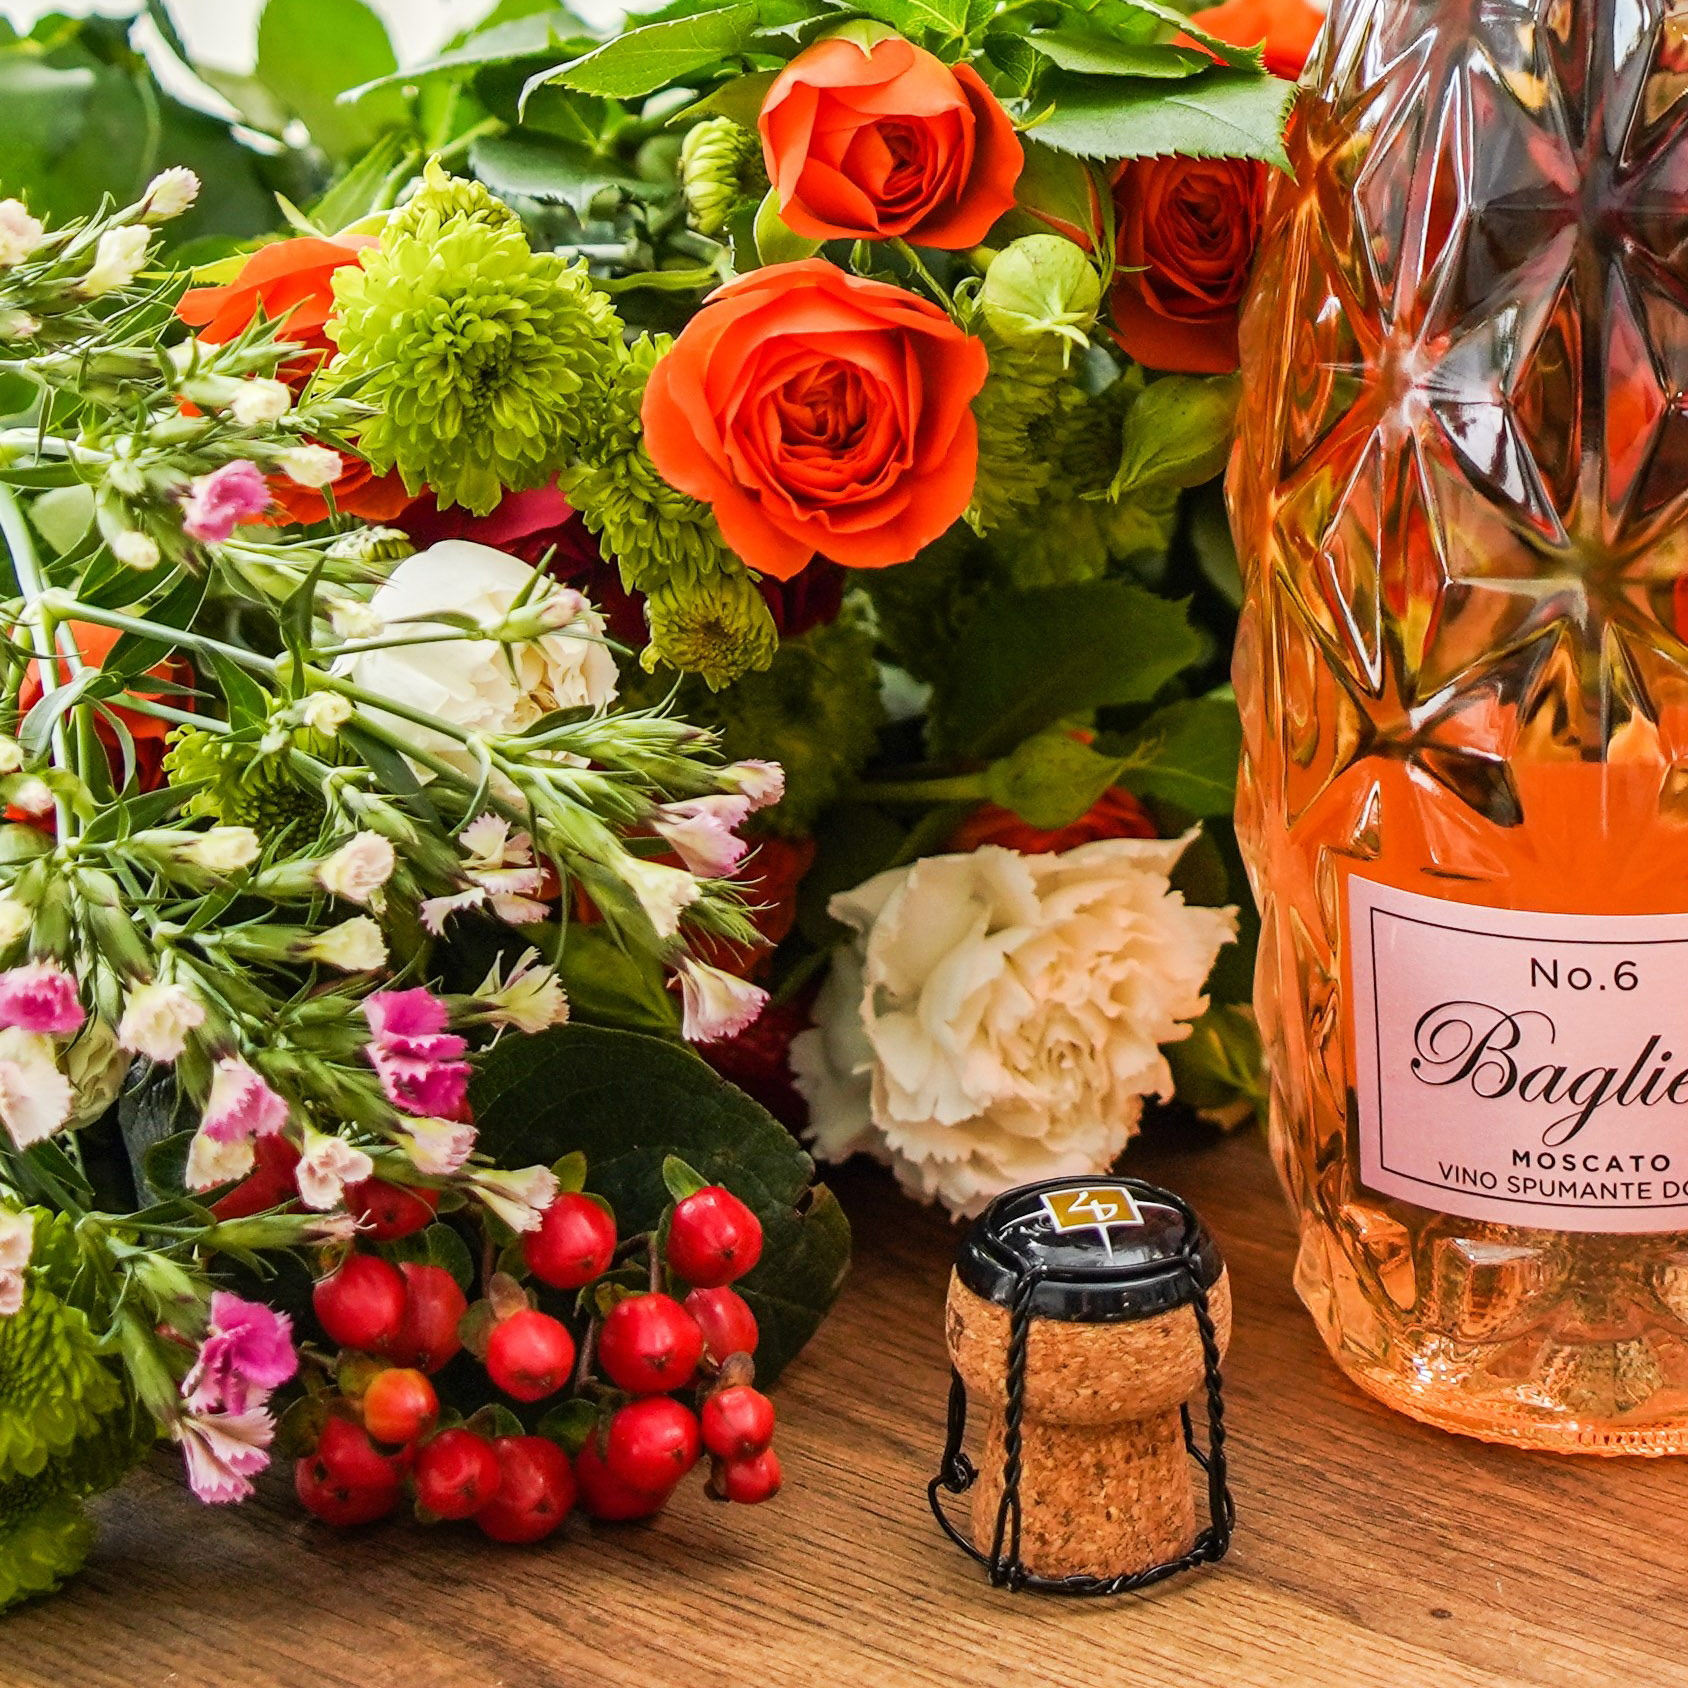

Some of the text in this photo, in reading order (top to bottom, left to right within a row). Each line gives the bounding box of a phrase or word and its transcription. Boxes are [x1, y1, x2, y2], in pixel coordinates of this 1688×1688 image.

[1530, 956, 1639, 992] No.6
[1512, 1149, 1671, 1173] MOSCATO
[1438, 1161, 1498, 1190] VINO
[1507, 1174, 1652, 1200] SPUMANTE
